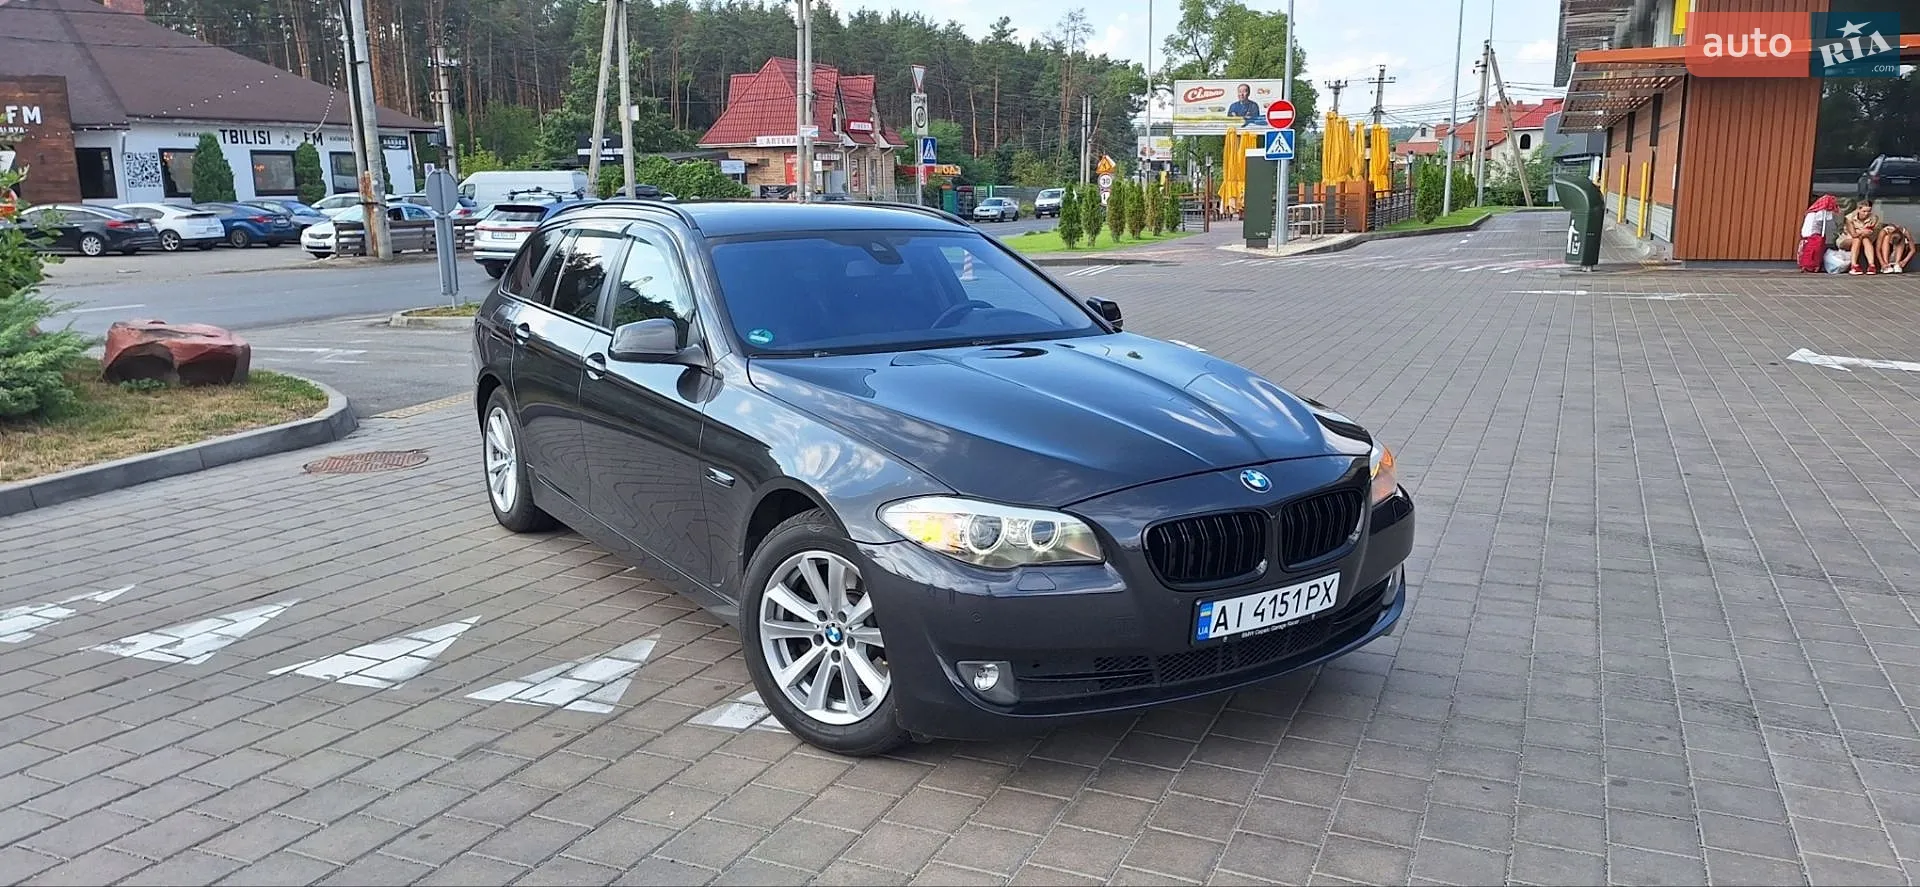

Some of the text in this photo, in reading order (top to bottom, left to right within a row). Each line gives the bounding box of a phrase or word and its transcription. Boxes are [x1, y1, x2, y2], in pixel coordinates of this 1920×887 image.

[5, 105, 42, 125] FM
[219, 129, 271, 145] TBILISI
[303, 132, 323, 146] FM
[1213, 602, 1243, 633] AI
[1198, 627, 1208, 635] UA
